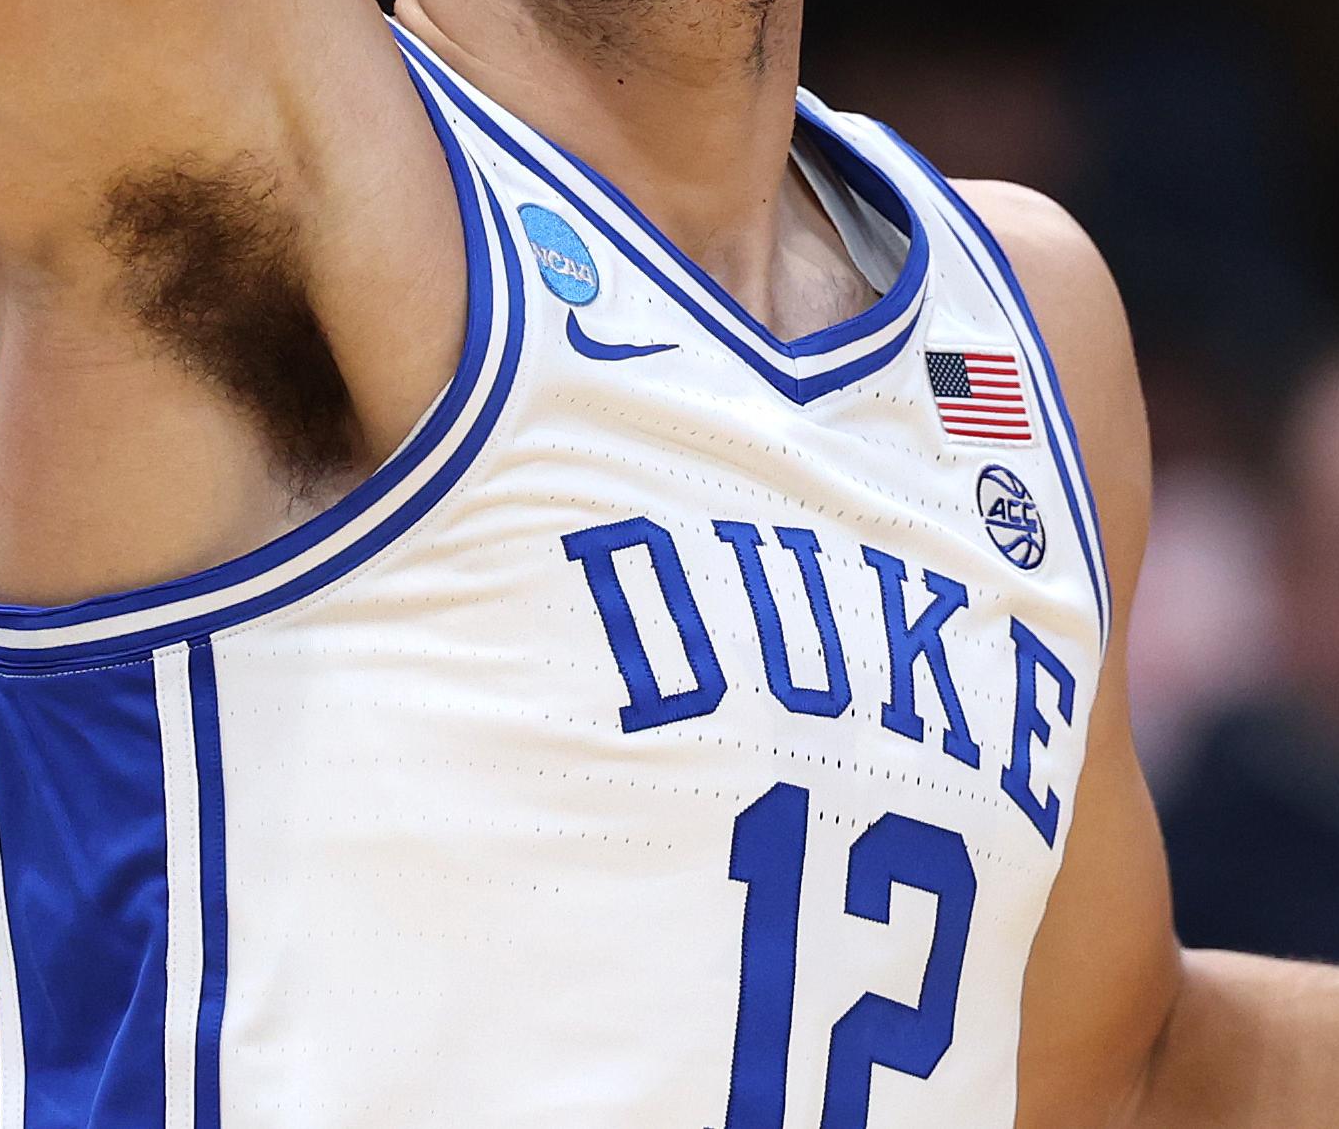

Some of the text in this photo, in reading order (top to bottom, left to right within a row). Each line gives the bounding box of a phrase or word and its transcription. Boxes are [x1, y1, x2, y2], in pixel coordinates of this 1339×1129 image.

[530, 242, 598, 287] NCAA
[988, 497, 1037, 526] ACC
[562, 517, 1076, 847] DUKE
[705, 781, 977, 1129] 12
